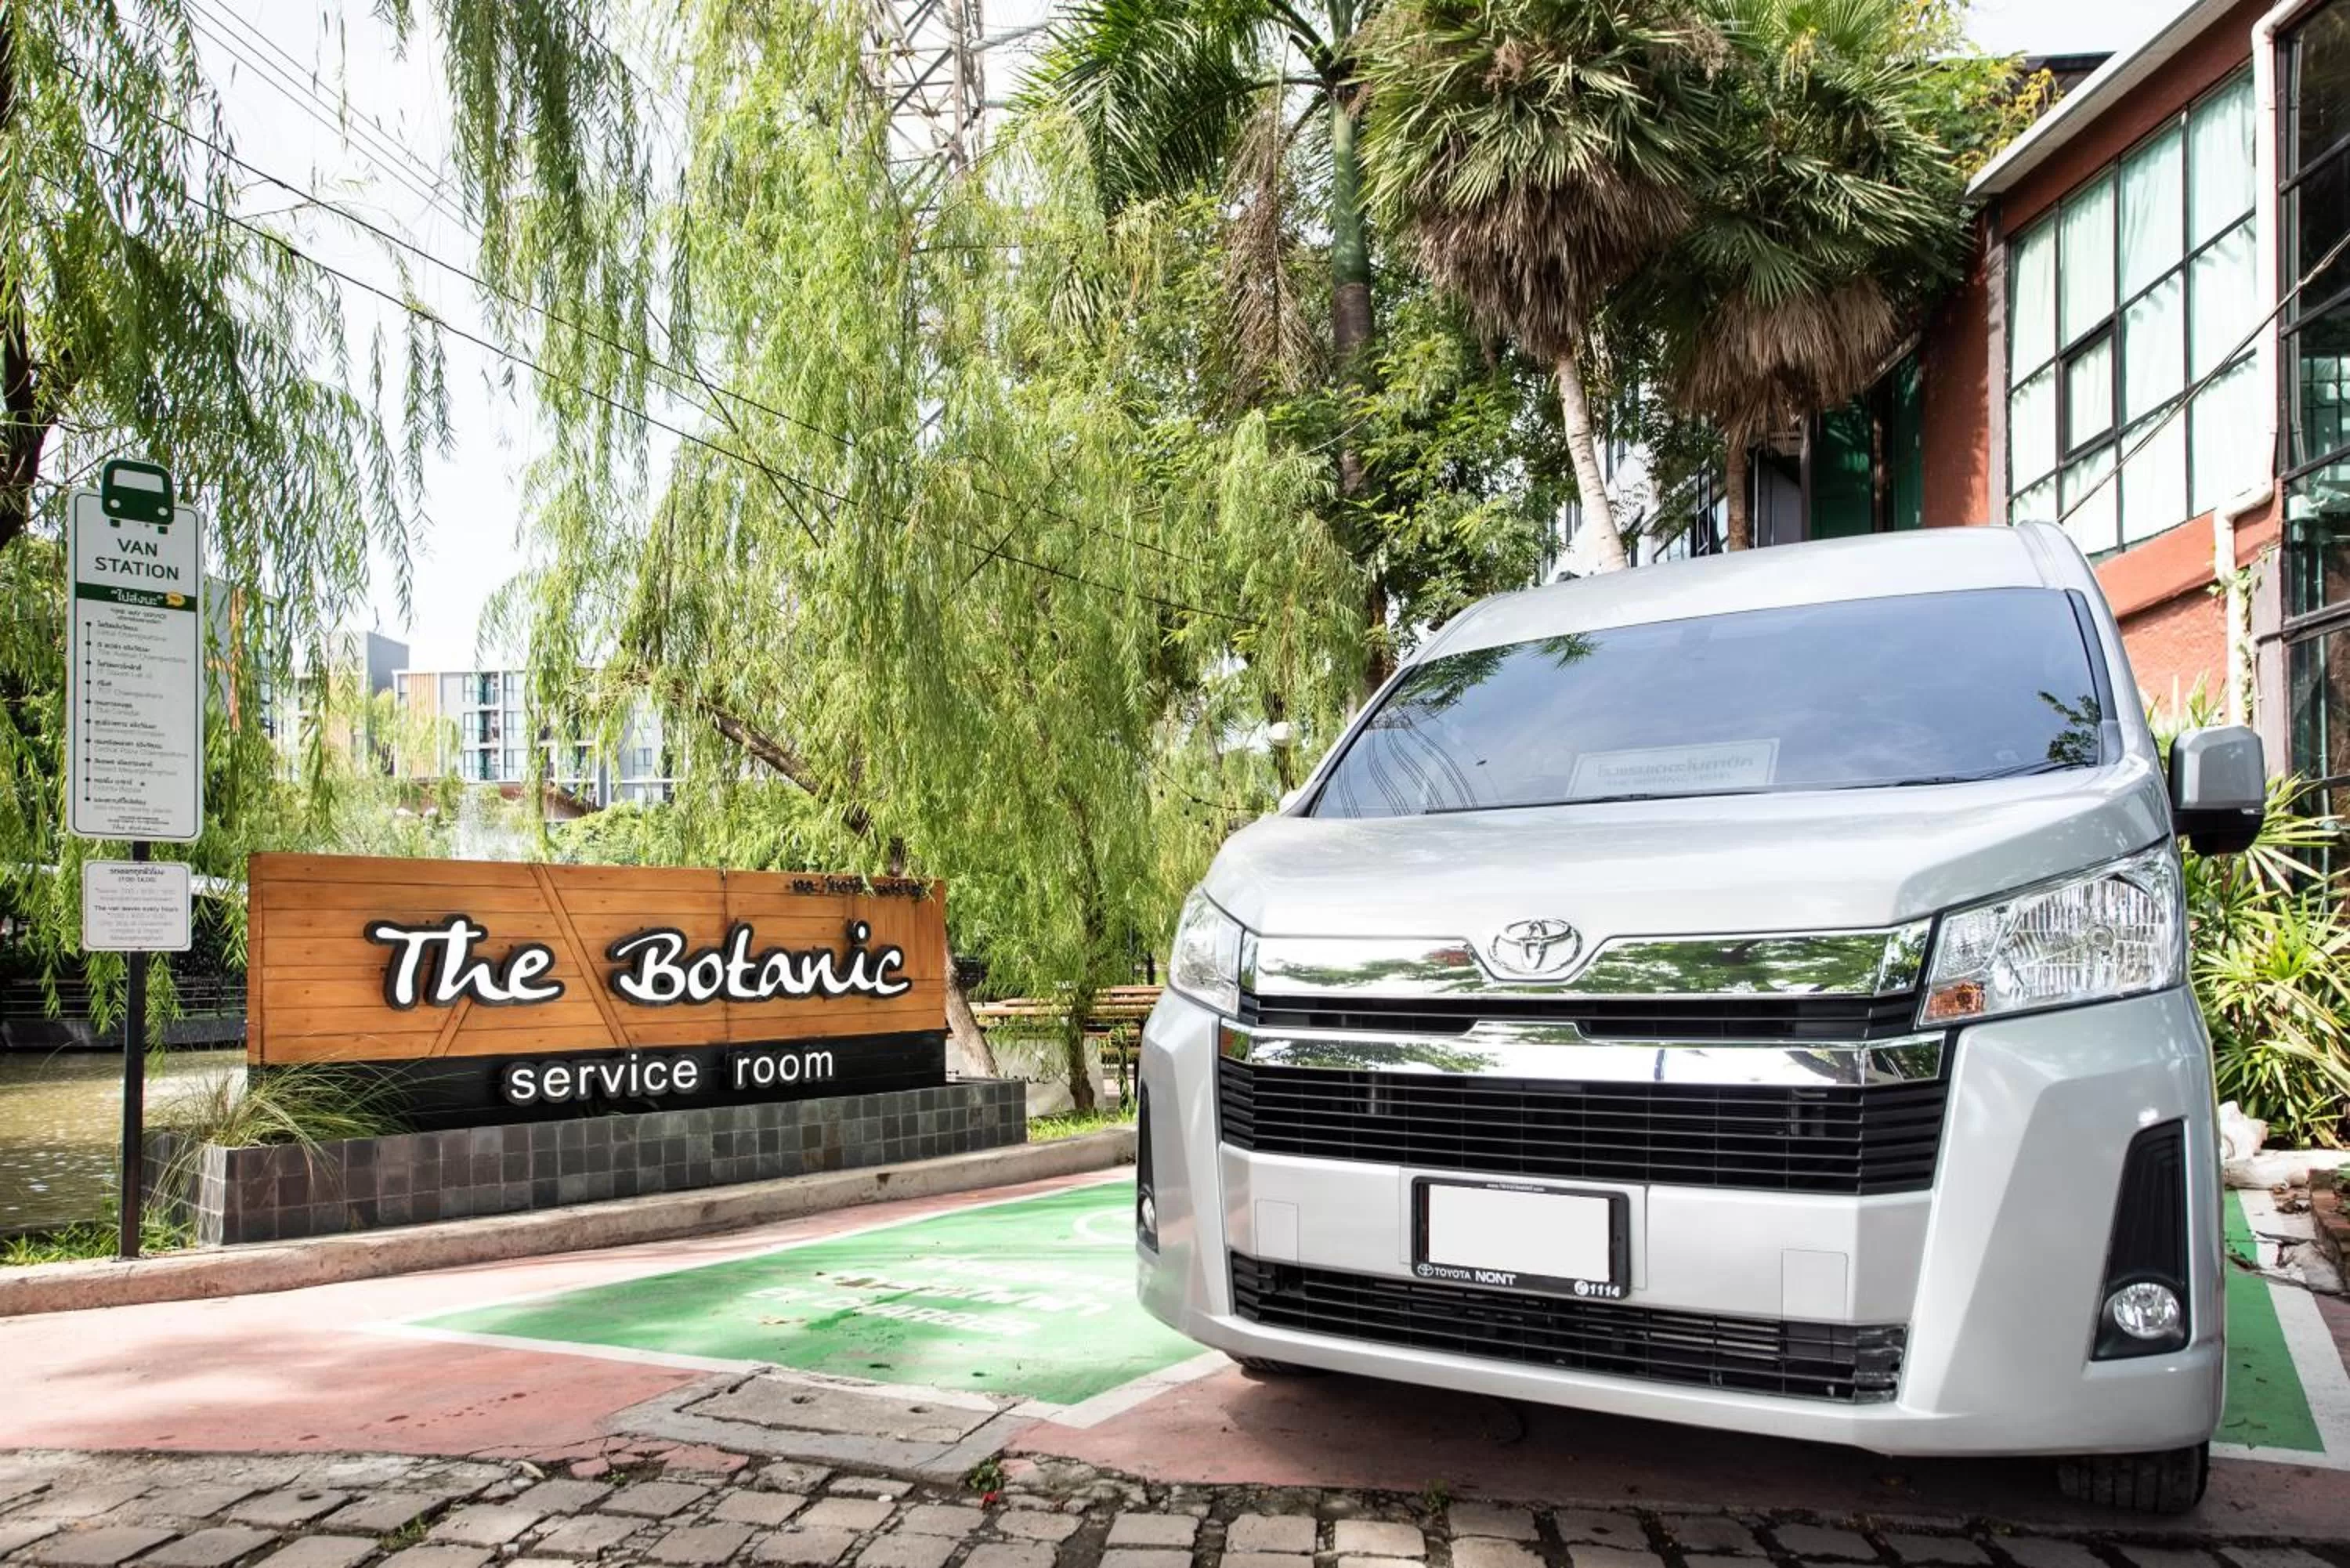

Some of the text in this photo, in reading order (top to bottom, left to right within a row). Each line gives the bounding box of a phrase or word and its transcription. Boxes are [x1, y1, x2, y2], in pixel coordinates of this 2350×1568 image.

[117, 538, 157, 557] VAN
[95, 556, 179, 580] STATION
[375, 919, 912, 1005] The Botanic
[511, 1050, 834, 1099] service room
[1434, 1266, 1517, 1286] TOYOTA NONT
[1589, 1284, 1622, 1298] 1114
